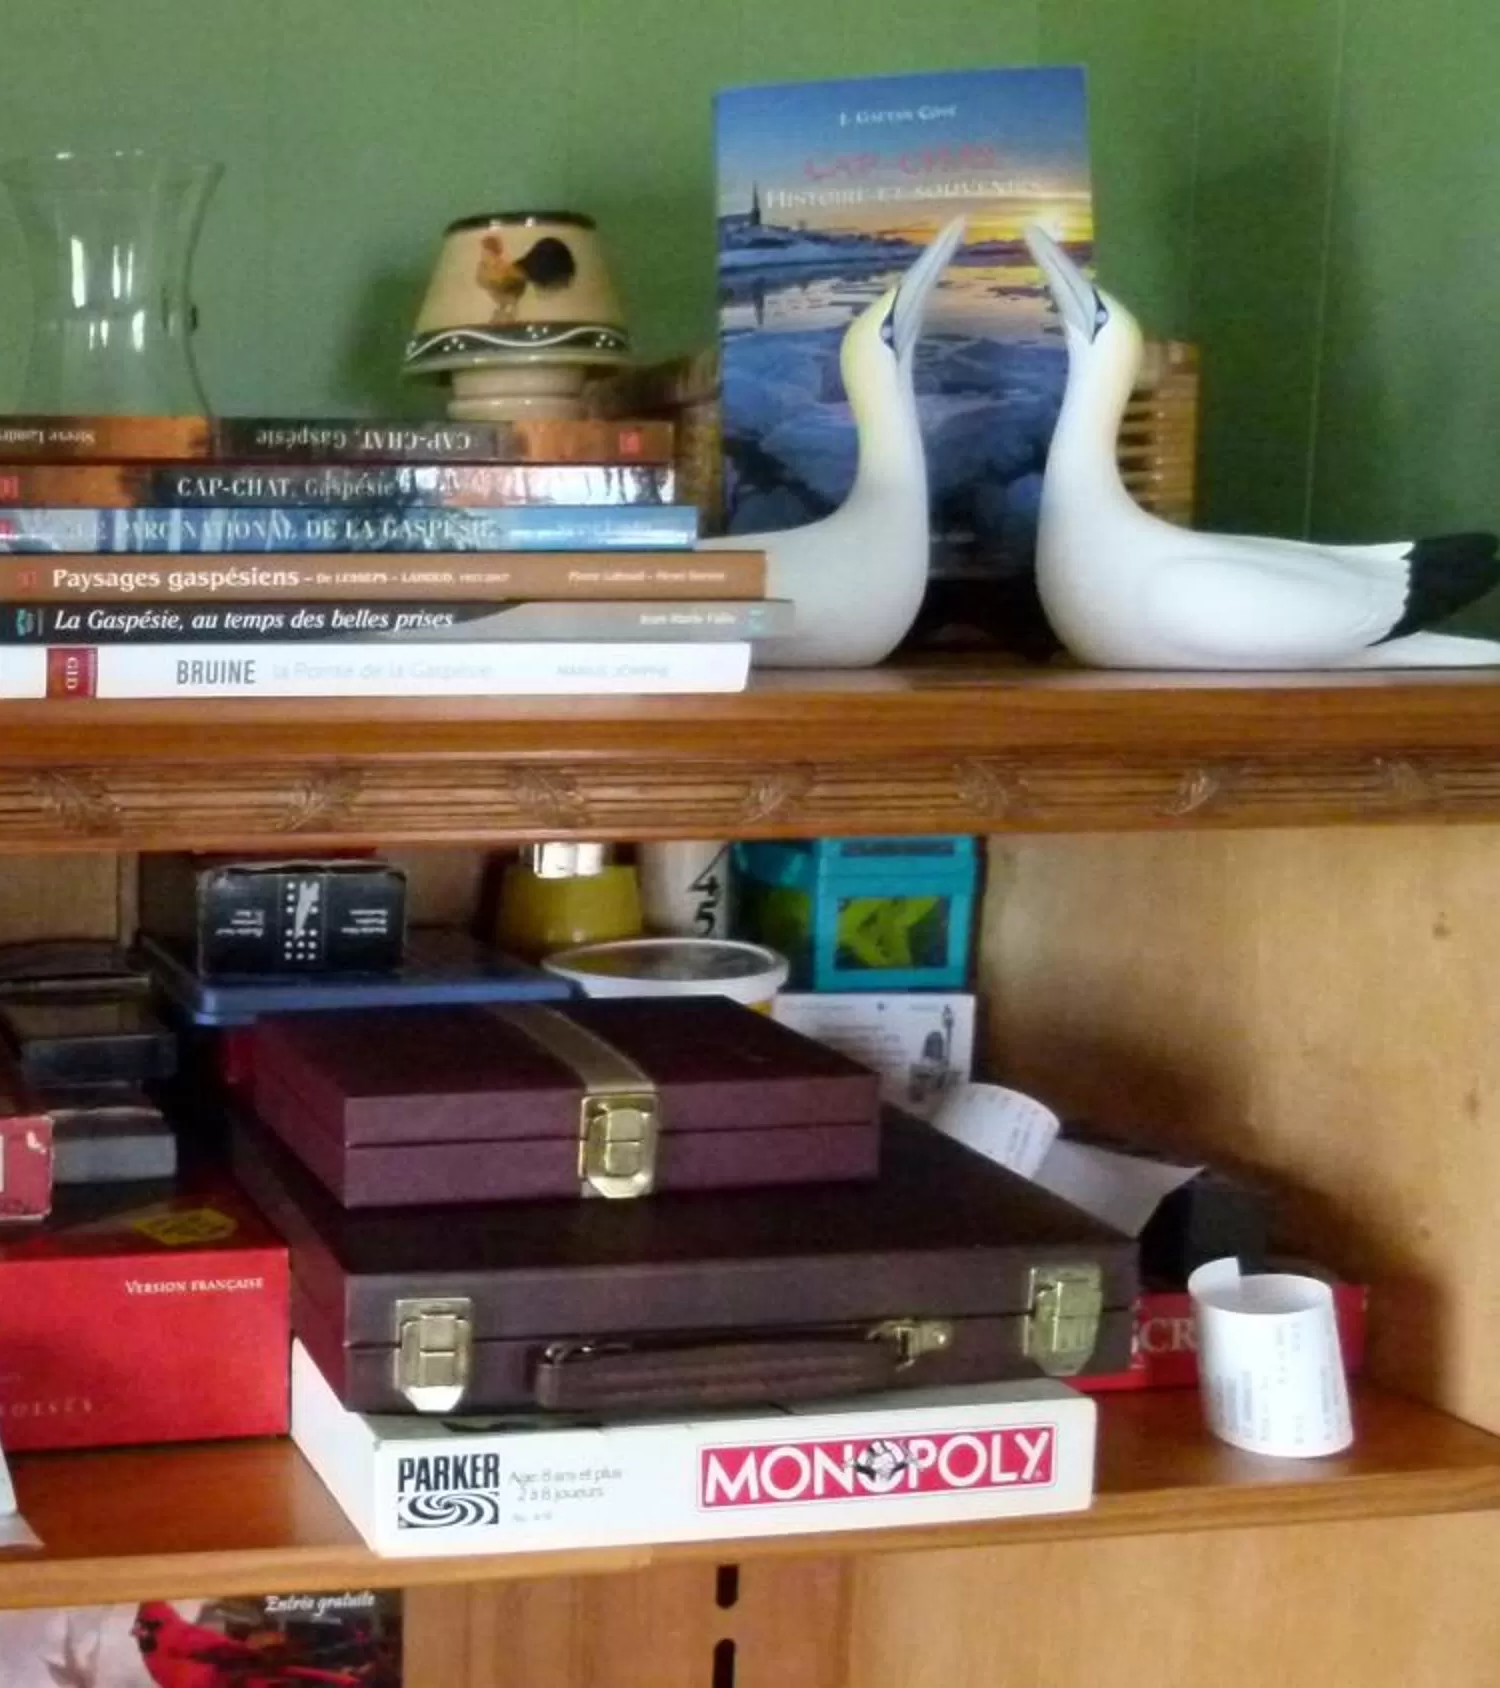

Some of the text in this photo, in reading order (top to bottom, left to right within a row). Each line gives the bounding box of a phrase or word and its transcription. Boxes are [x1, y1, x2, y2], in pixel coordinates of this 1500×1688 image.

[306, 519, 337, 540] DE
[346, 519, 376, 540] LA
[53, 568, 161, 593] Paysages
[168, 566, 300, 592] gaspésiens
[55, 607, 455, 634] La Gaspésie, au temps des belles prises
[175, 659, 257, 685] BRUINE
[398, 1452, 500, 1493] PARKER
[704, 1431, 1051, 1505] MONOPOLY
